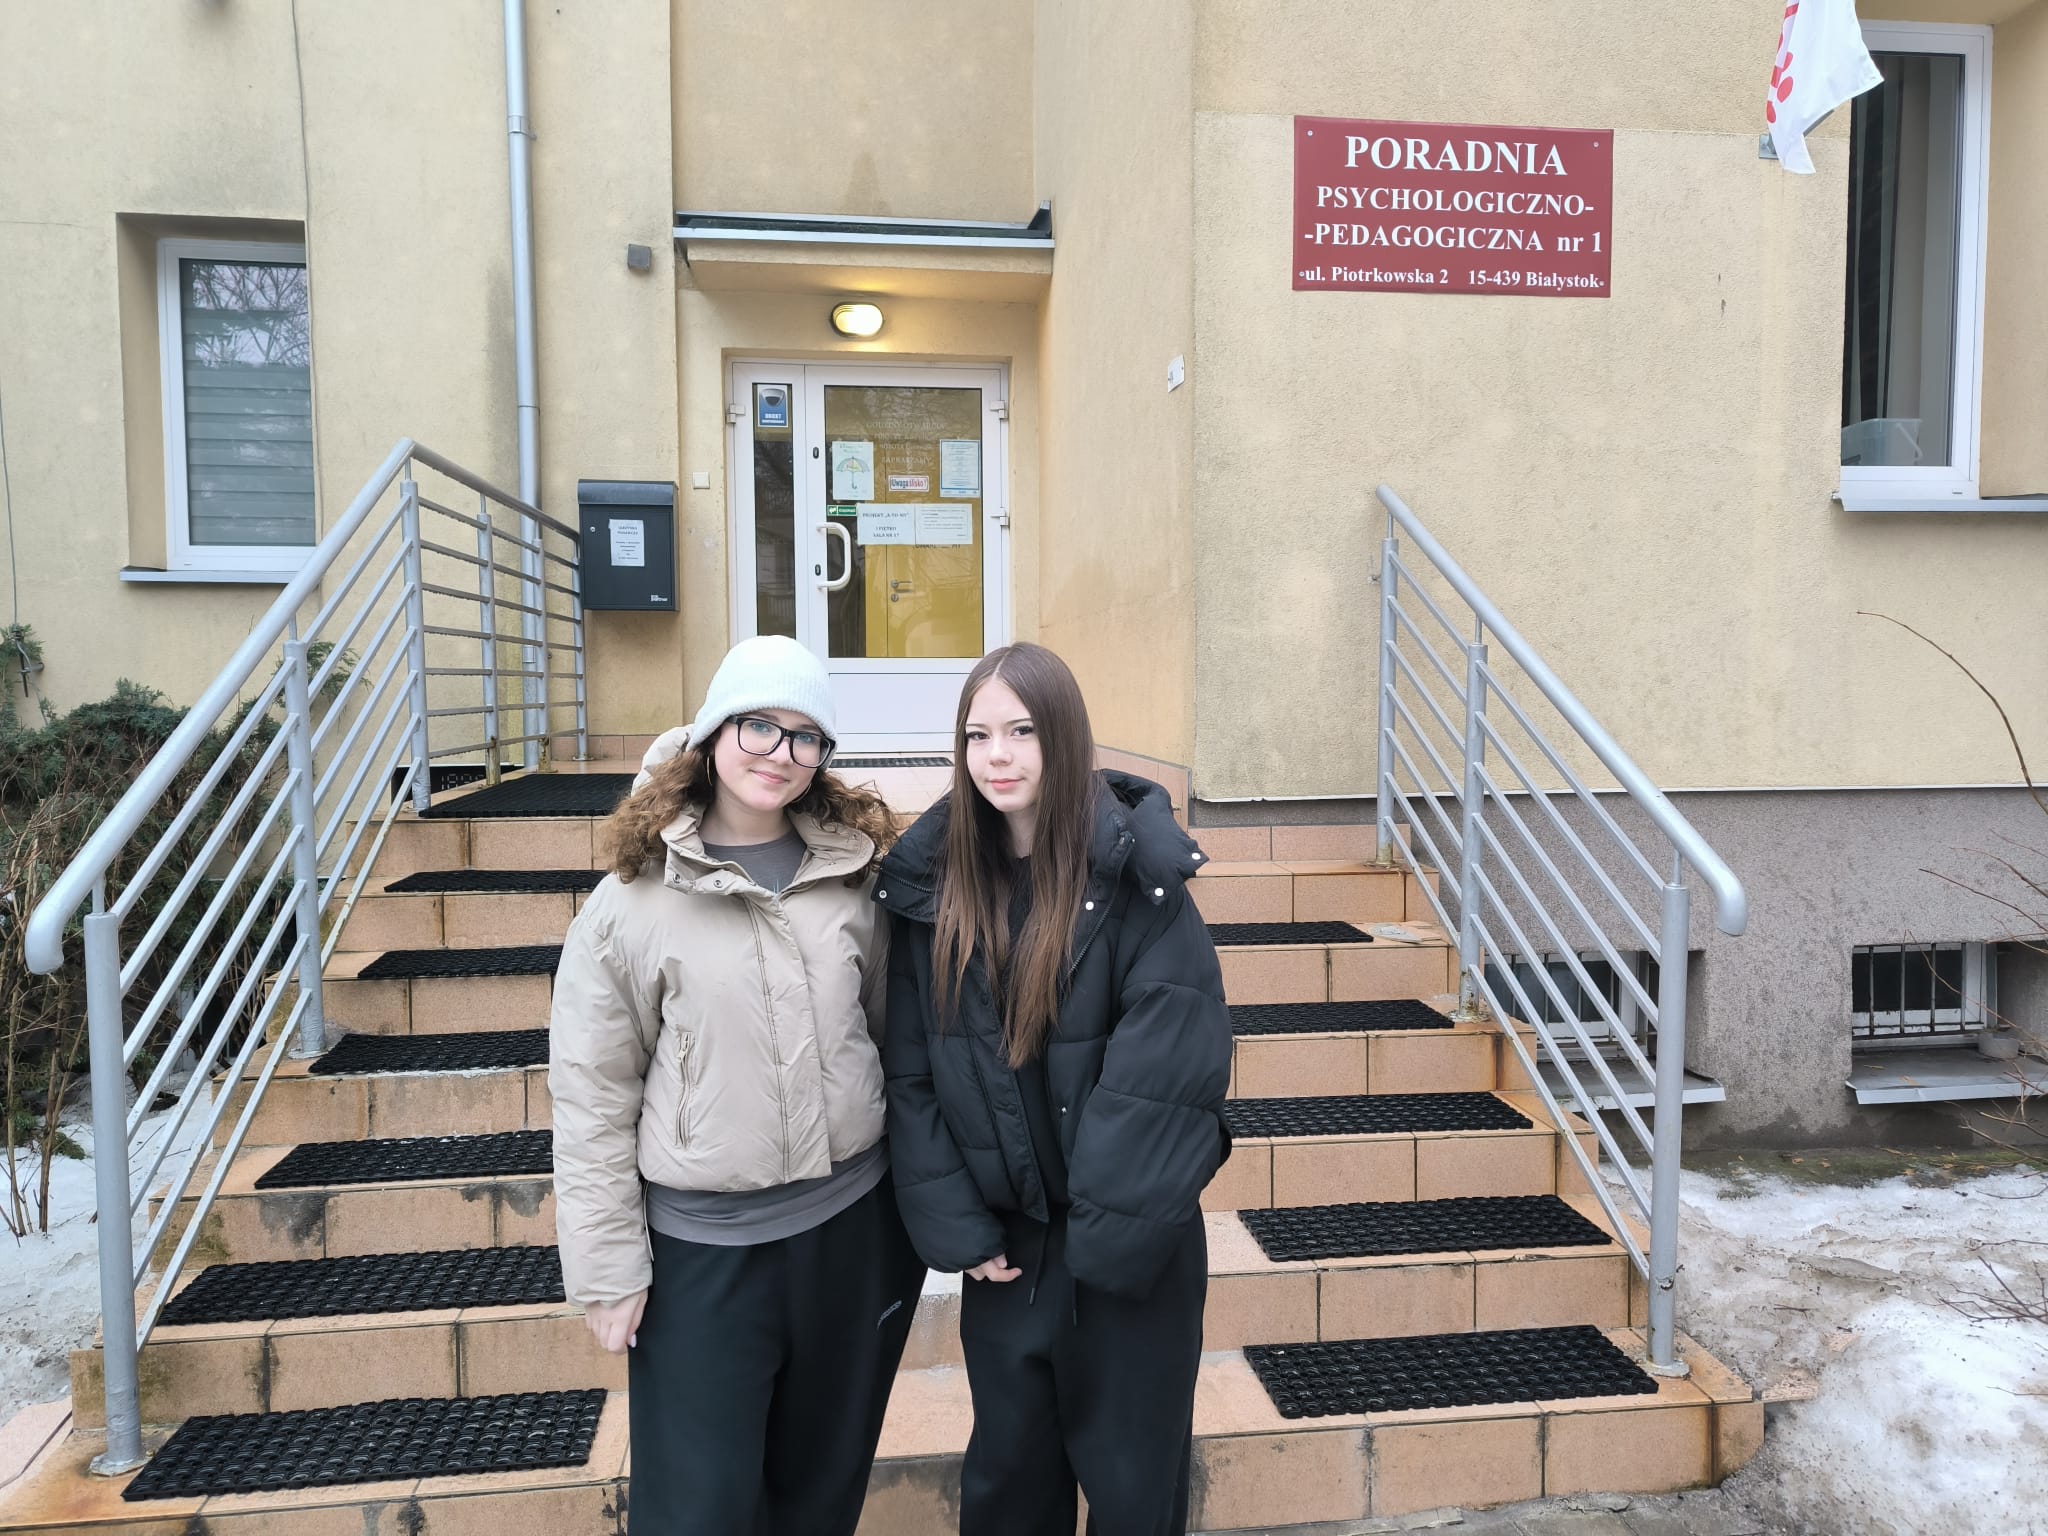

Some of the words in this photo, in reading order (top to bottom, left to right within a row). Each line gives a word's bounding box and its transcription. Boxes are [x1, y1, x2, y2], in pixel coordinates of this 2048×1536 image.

[1344, 135, 1568, 176] PORADNIA
[1316, 185, 1594, 216] PSYCHOLOGICZNO-
[1304, 222, 1544, 251] -PEDAGOGICZNA
[1557, 236, 1585, 252] nr
[1591, 231, 1602, 253] 1
[1305, 266, 1326, 281] ul.
[1331, 266, 1435, 284] Piotrkowska
[1439, 268, 1449, 284] 2
[1468, 269, 1521, 286] 15-439
[1526, 271, 1600, 292] Białystok
